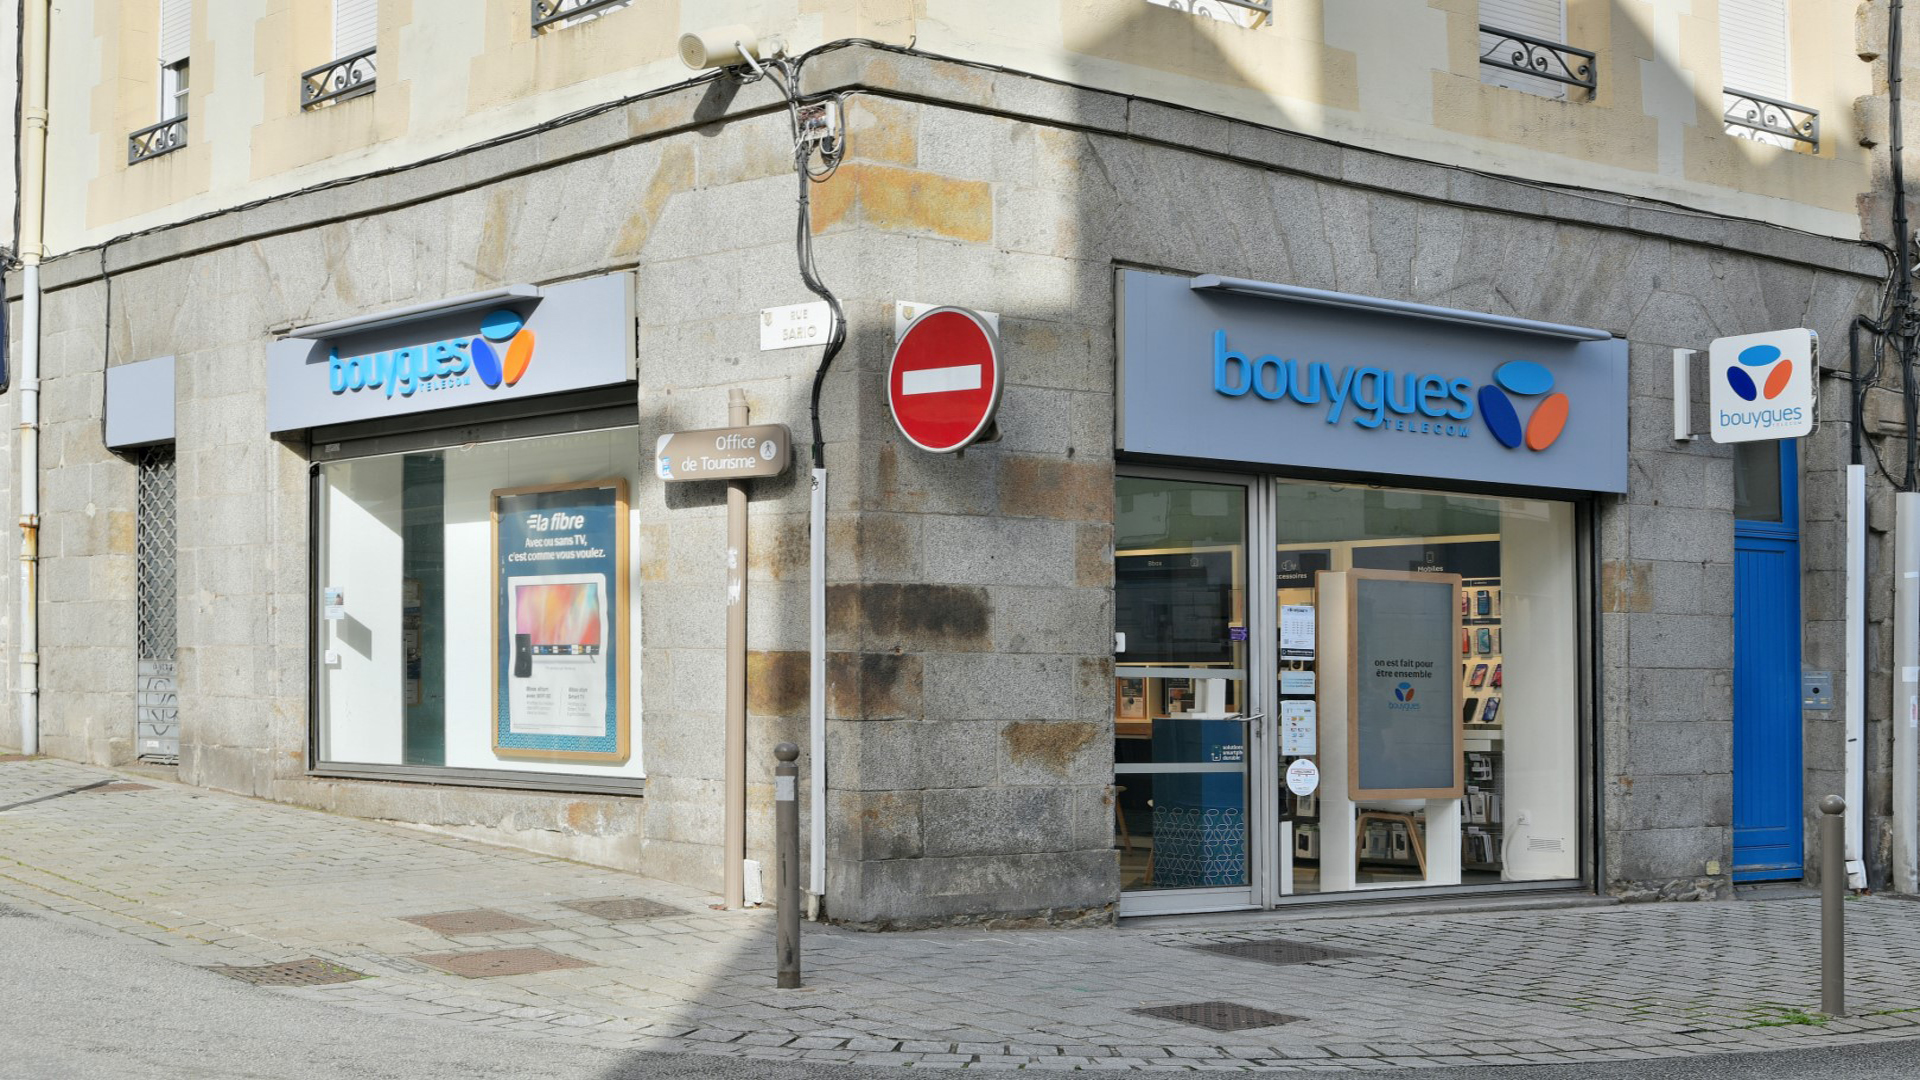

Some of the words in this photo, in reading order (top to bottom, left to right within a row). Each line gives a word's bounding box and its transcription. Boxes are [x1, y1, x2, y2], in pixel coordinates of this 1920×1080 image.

[791, 309, 808, 320] RUE
[329, 338, 473, 400] bouygues
[419, 377, 471, 392] TELECOM
[1214, 329, 1474, 428] bouygues
[1720, 407, 1802, 428] bouygues
[1384, 418, 1470, 438] TELECOM
[716, 434, 756, 450] Office
[681, 456, 697, 472] de
[700, 455, 756, 471] Tourisme
[536, 514, 549, 531] la
[550, 512, 584, 531] fibre
[525, 537, 542, 548] Avec
[543, 539, 553, 547] ou
[554, 537, 574, 547] sans
[528, 551, 555, 561] comme
[556, 550, 576, 560] vous
[1277, 572, 1307, 580] ccessoires
[1386, 659, 1398, 667] est
[1400, 658, 1414, 668] fait
[1415, 661, 1434, 669] pour
[1394, 670, 1433, 678] ensemble
